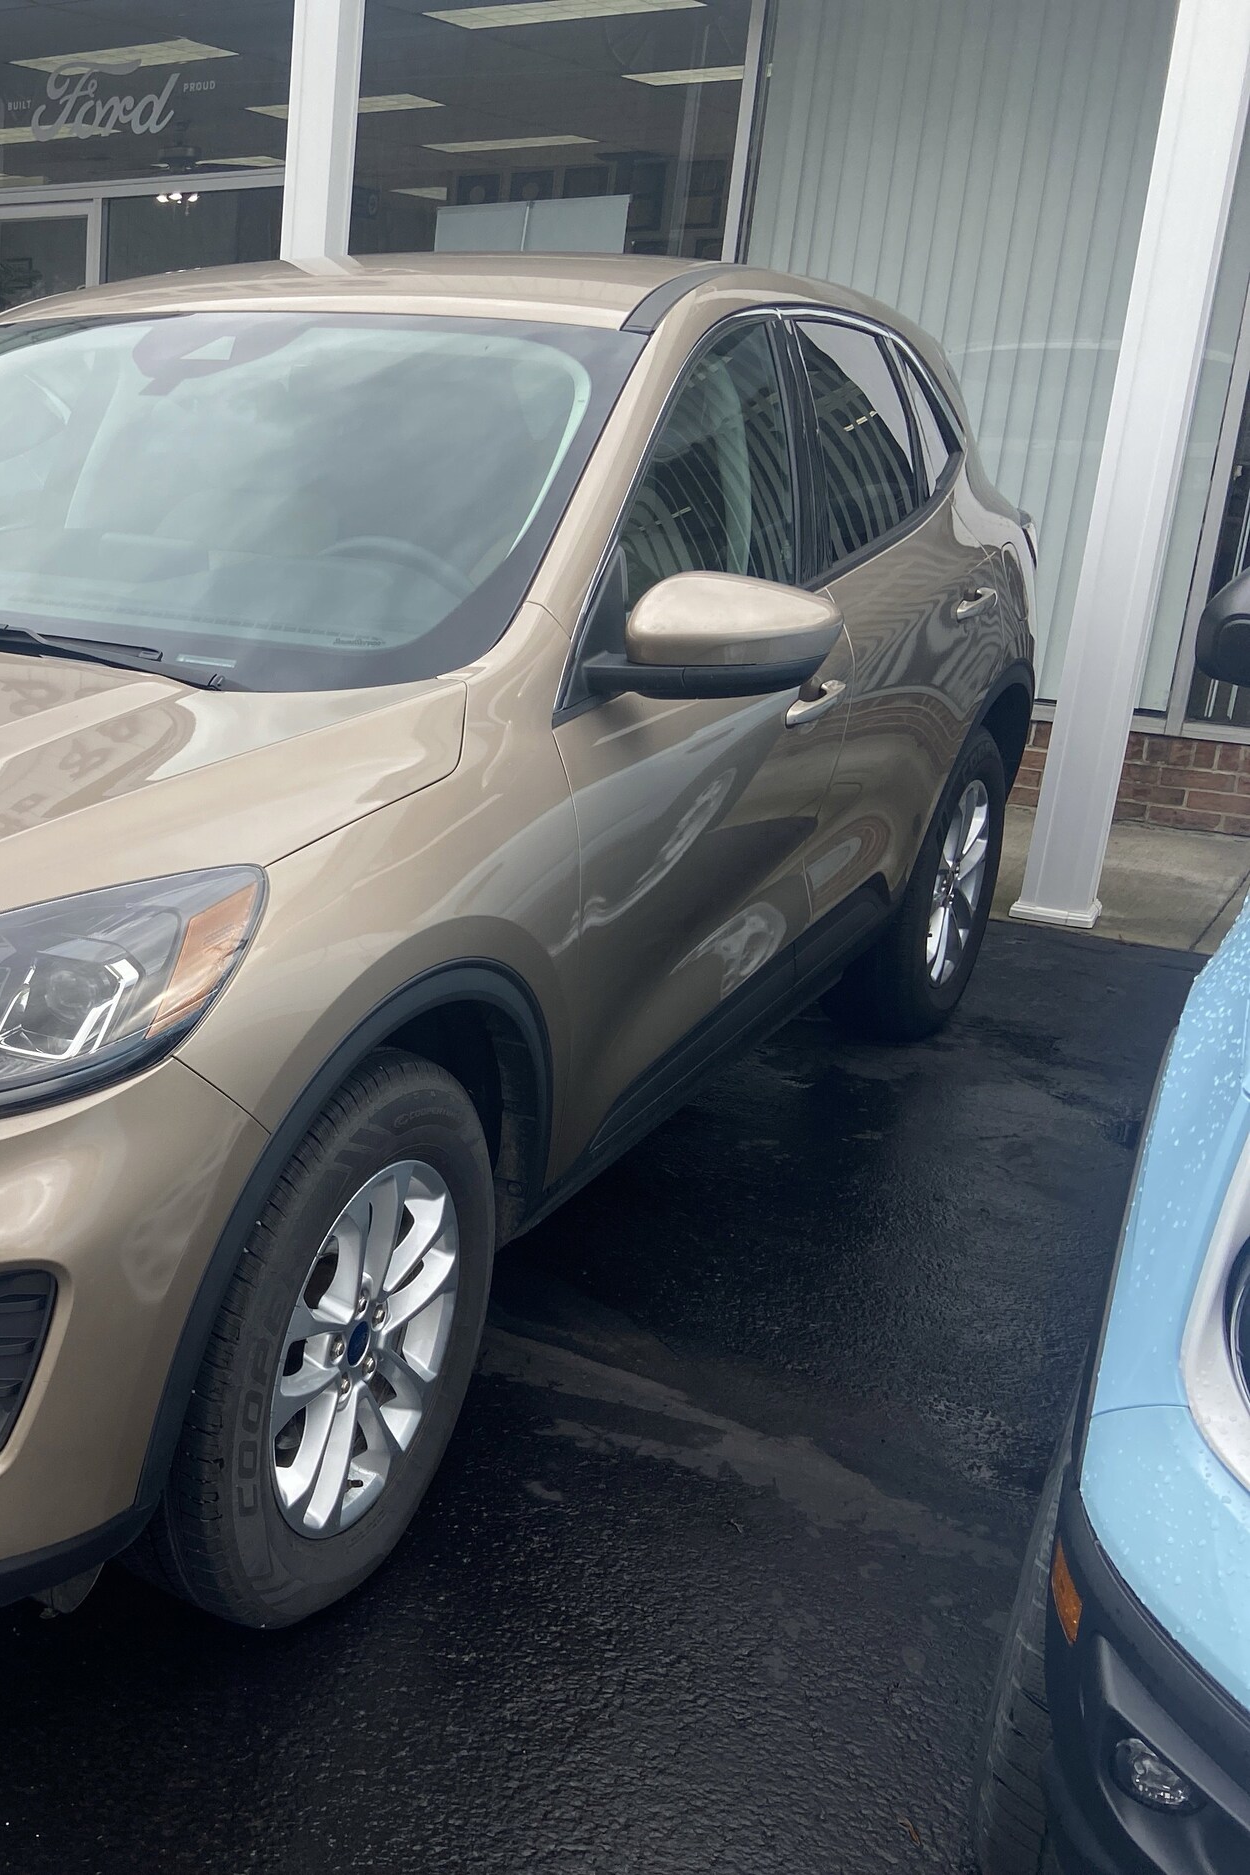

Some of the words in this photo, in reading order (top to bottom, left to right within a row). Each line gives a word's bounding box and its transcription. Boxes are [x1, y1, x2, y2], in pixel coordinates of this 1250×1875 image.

[7, 99, 32, 112] BUILT
[30, 58, 181, 142] Ford
[183, 80, 216, 93] PROUD
